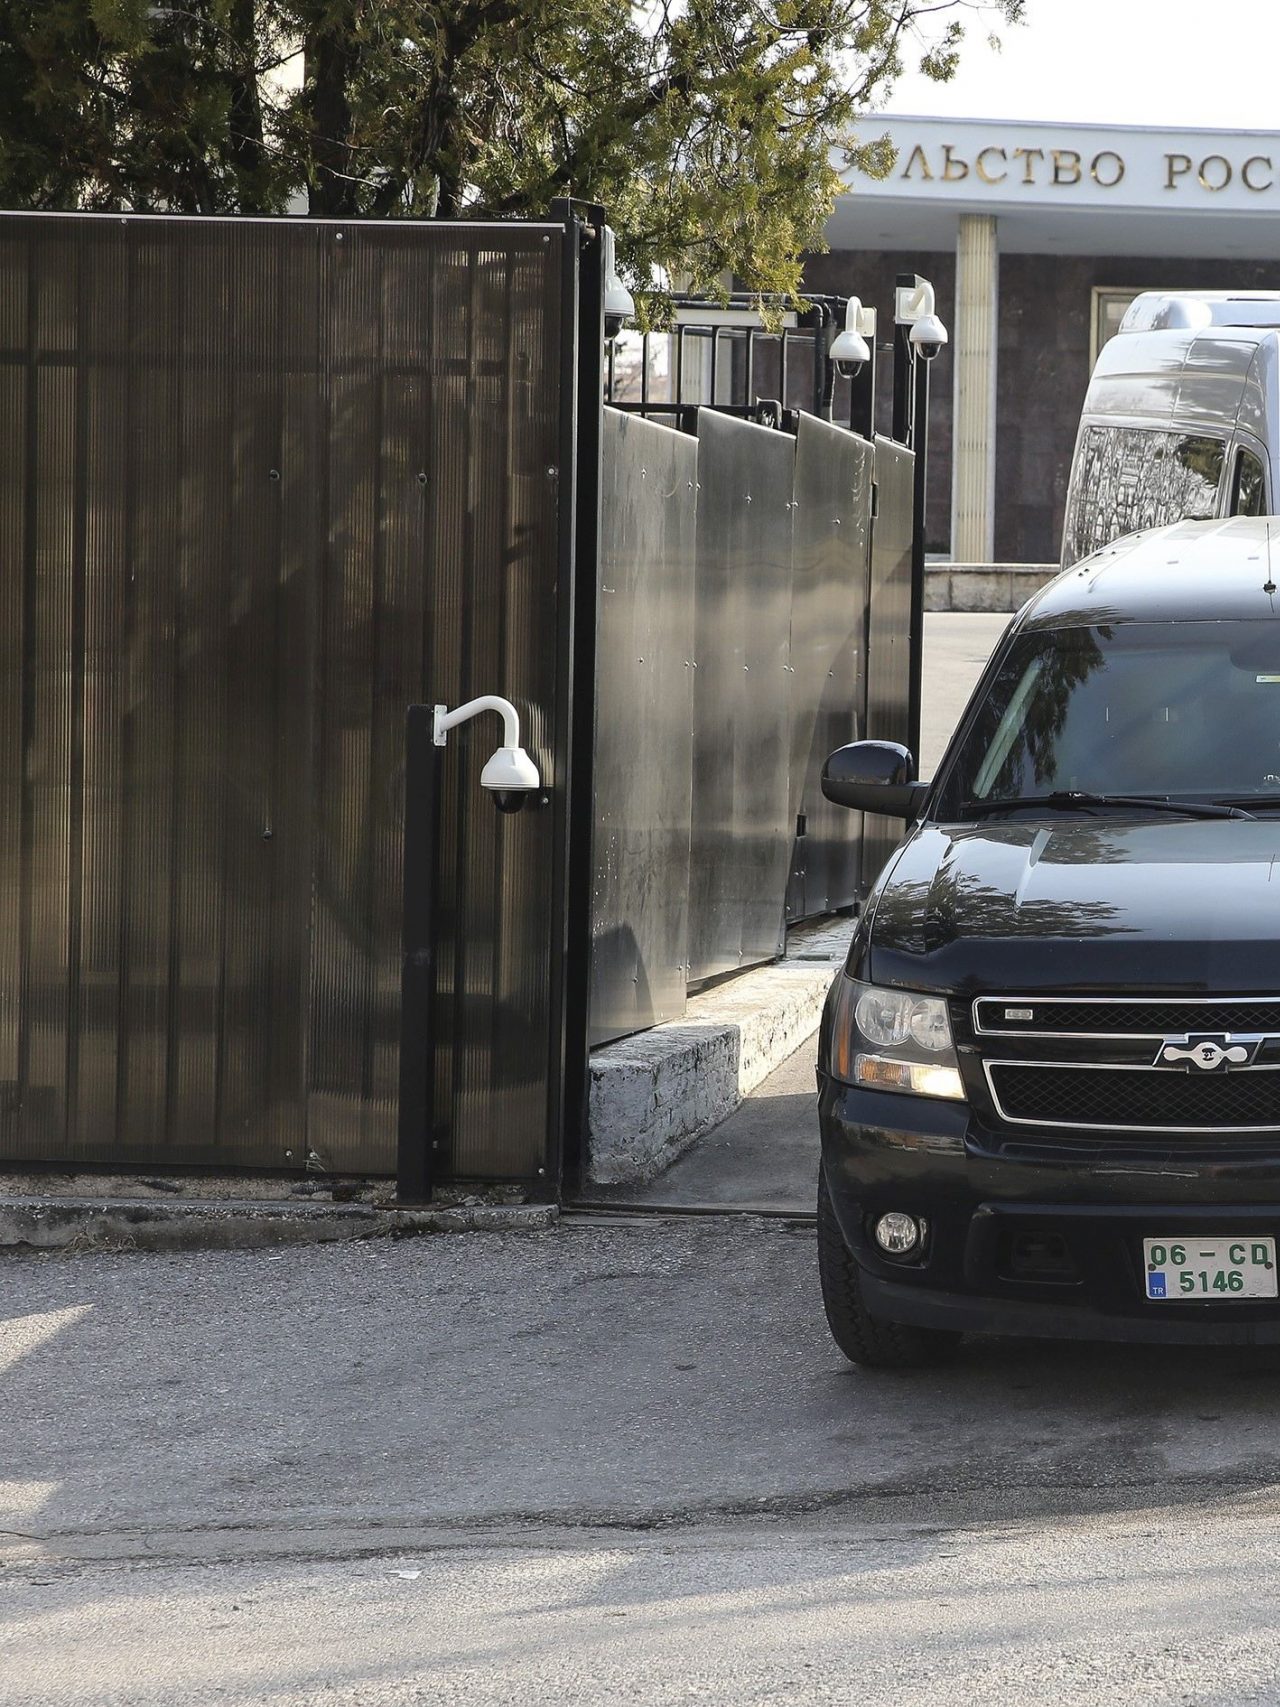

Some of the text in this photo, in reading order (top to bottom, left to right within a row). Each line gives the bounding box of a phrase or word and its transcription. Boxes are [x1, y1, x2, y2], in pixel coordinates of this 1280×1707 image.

[838, 142, 1126, 188] ЛЬСТВО
[1150, 1244, 1187, 1266] 06
[1229, 1243, 1269, 1265] CD
[1152, 1287, 1164, 1295] TR
[1179, 1270, 1244, 1293] 5146
